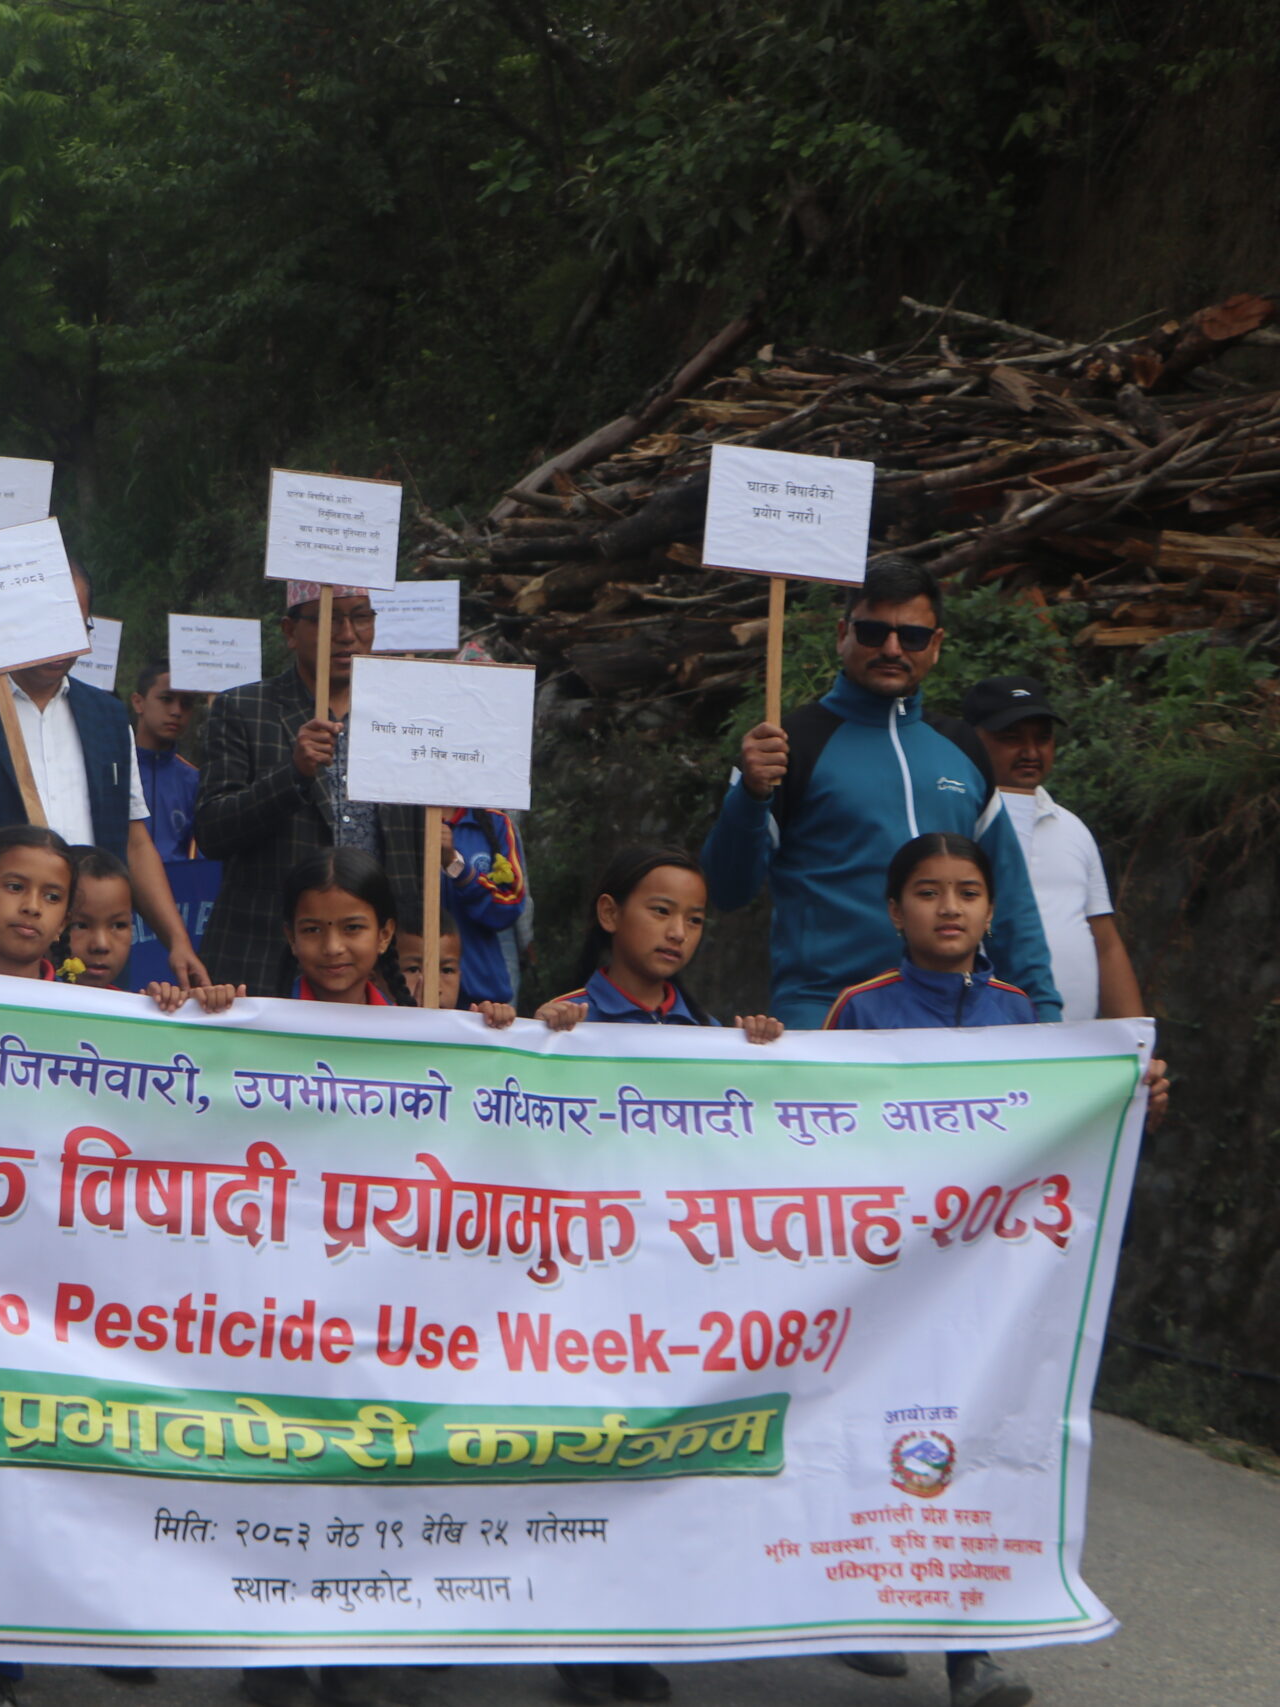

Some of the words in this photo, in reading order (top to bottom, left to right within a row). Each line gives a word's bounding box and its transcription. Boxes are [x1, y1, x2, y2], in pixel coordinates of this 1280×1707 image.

[747, 481, 780, 494] घातक
[752, 504, 781, 520] प्रयोग
[401, 723, 423, 737] प्रयोग
[234, 1061, 452, 1122] उपभोक्ताको
[775, 1100, 858, 1145] मुक्त
[881, 1091, 1030, 1135] आहार”
[58, 1126, 296, 1248] विषादी
[320, 1152, 641, 1285] प्रयोगमुक्त
[665, 1173, 1074, 1267] सप्ताह-२०८३
[53, 1282, 355, 1365] Pesticide
[375, 1304, 480, 1371] Use
[884, 1404, 959, 1425] आयोजक
[443, 1409, 779, 1468] कार्यक्रम
[236, 1519, 311, 1551] २०८३
[326, 1516, 365, 1548] जेठ
[376, 1520, 404, 1549] १९
[421, 1513, 468, 1545] देखि
[480, 1519, 508, 1546] २५
[526, 1511, 609, 1544] गतेसम्म
[850, 1503, 914, 1526] कर्णाली
[954, 1508, 992, 1527] सरकार
[764, 1538, 801, 1563] भूमि
[889, 1529, 926, 1556] कृषि
[910, 1557, 944, 1582] कृषि
[311, 1569, 422, 1612] कपुरकोट,
[434, 1576, 512, 1602] सल्यान
